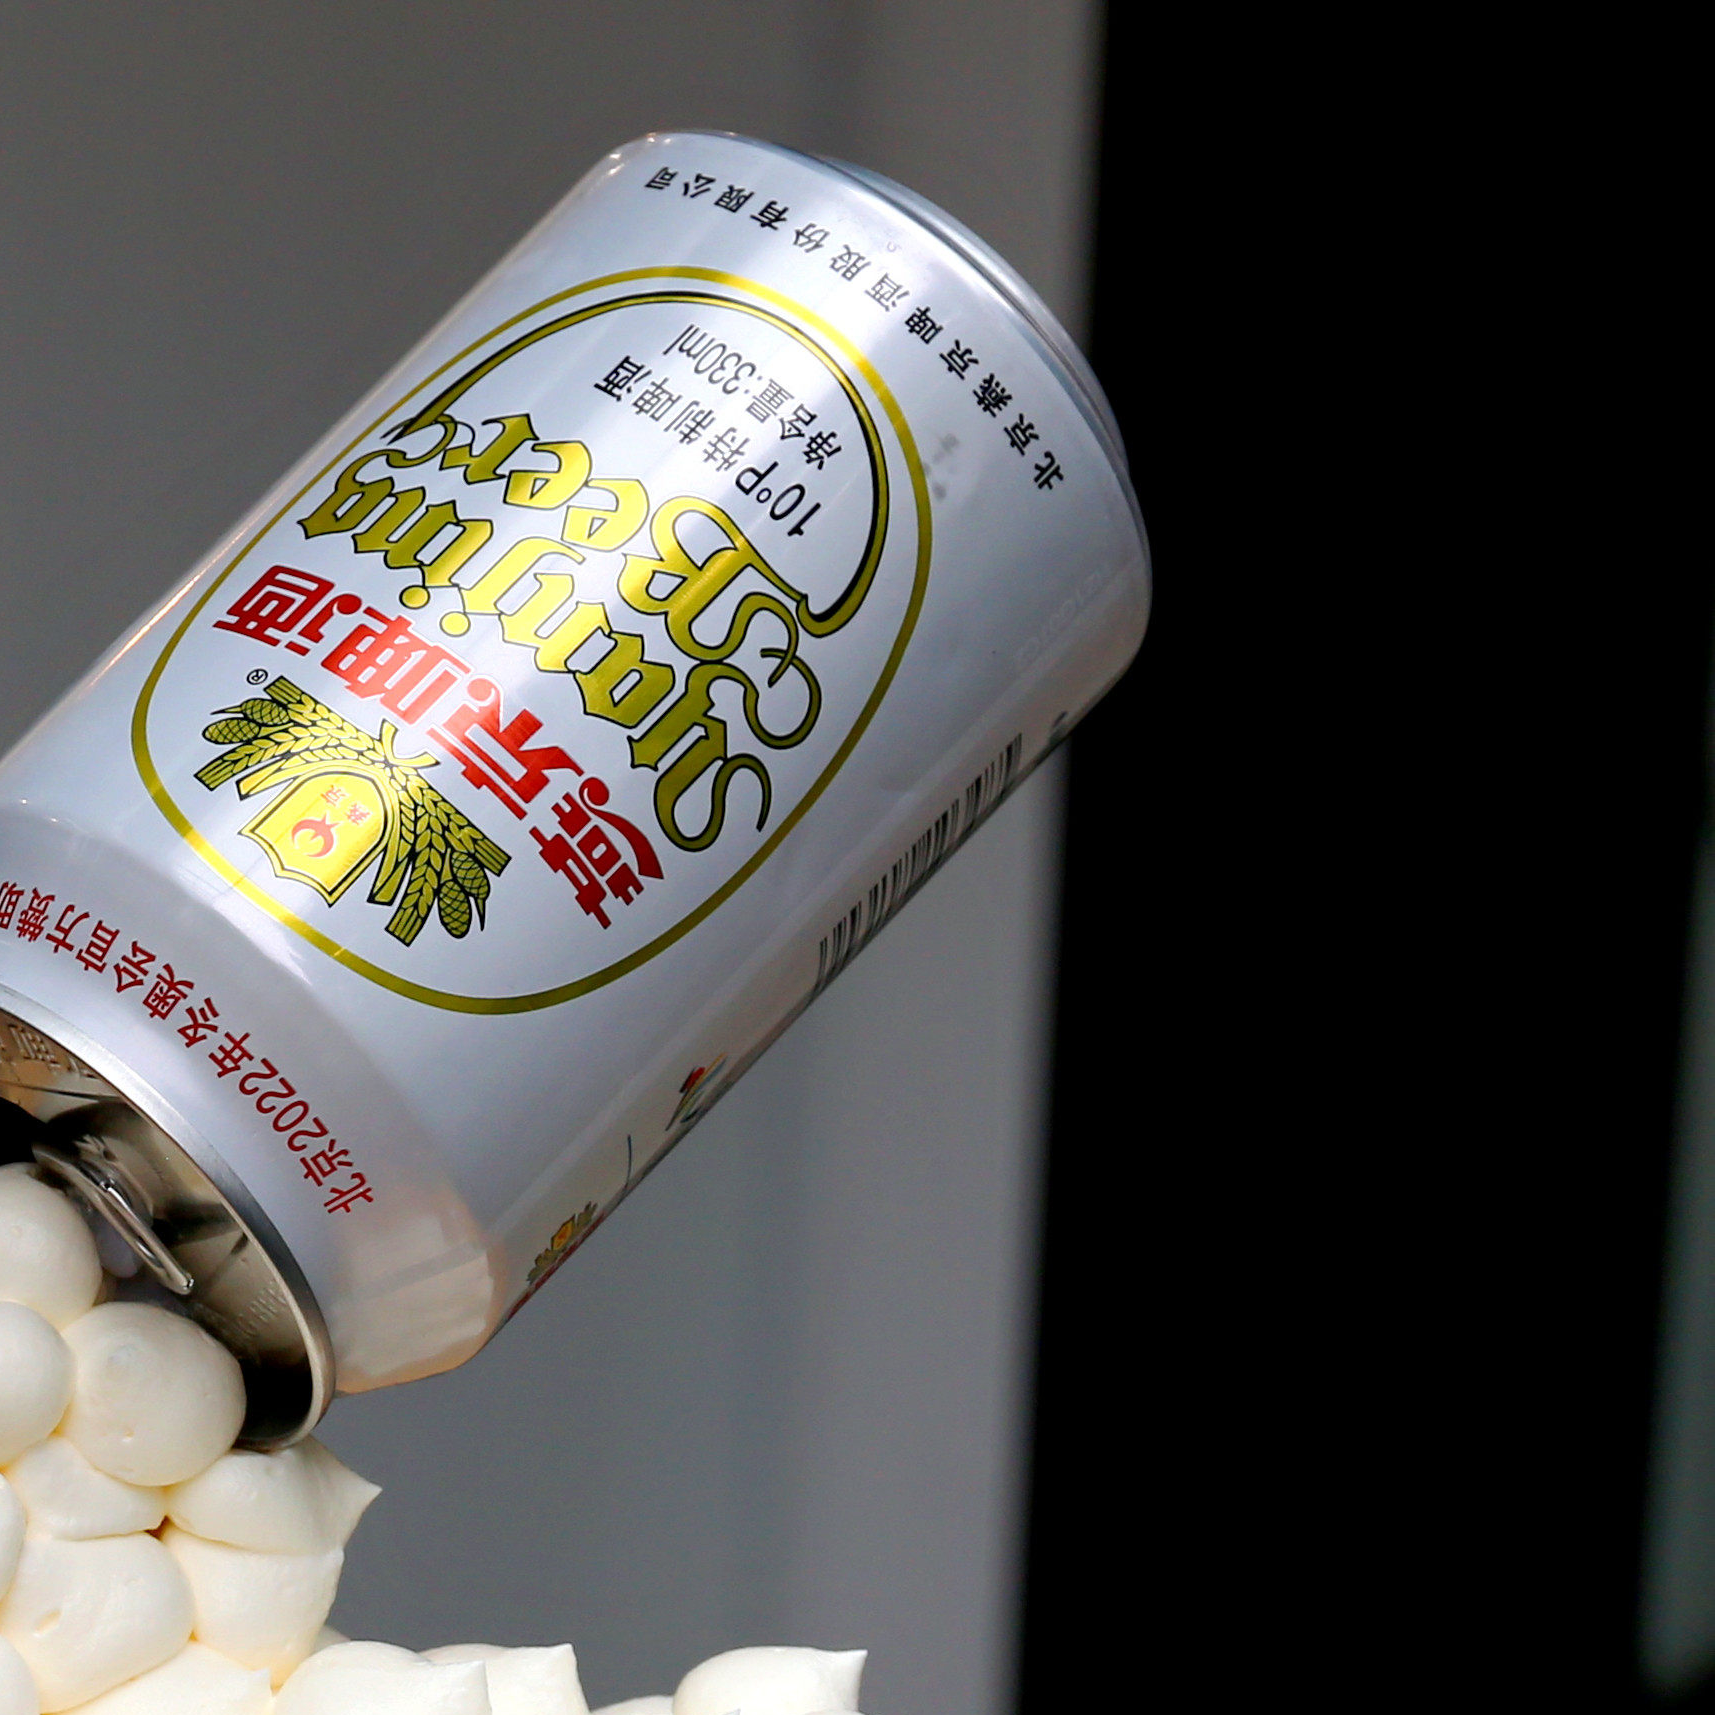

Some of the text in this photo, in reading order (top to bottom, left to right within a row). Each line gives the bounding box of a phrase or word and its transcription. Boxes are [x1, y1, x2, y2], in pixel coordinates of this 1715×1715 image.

[644, 165, 1065, 492] 北京燕京啤酒股份有限公司
[295, 438, 815, 853] Yanjing
[391, 410, 807, 668] Beer
[213, 564, 665, 930] 燕京啤酒
[320, 784, 371, 826] 燕京
